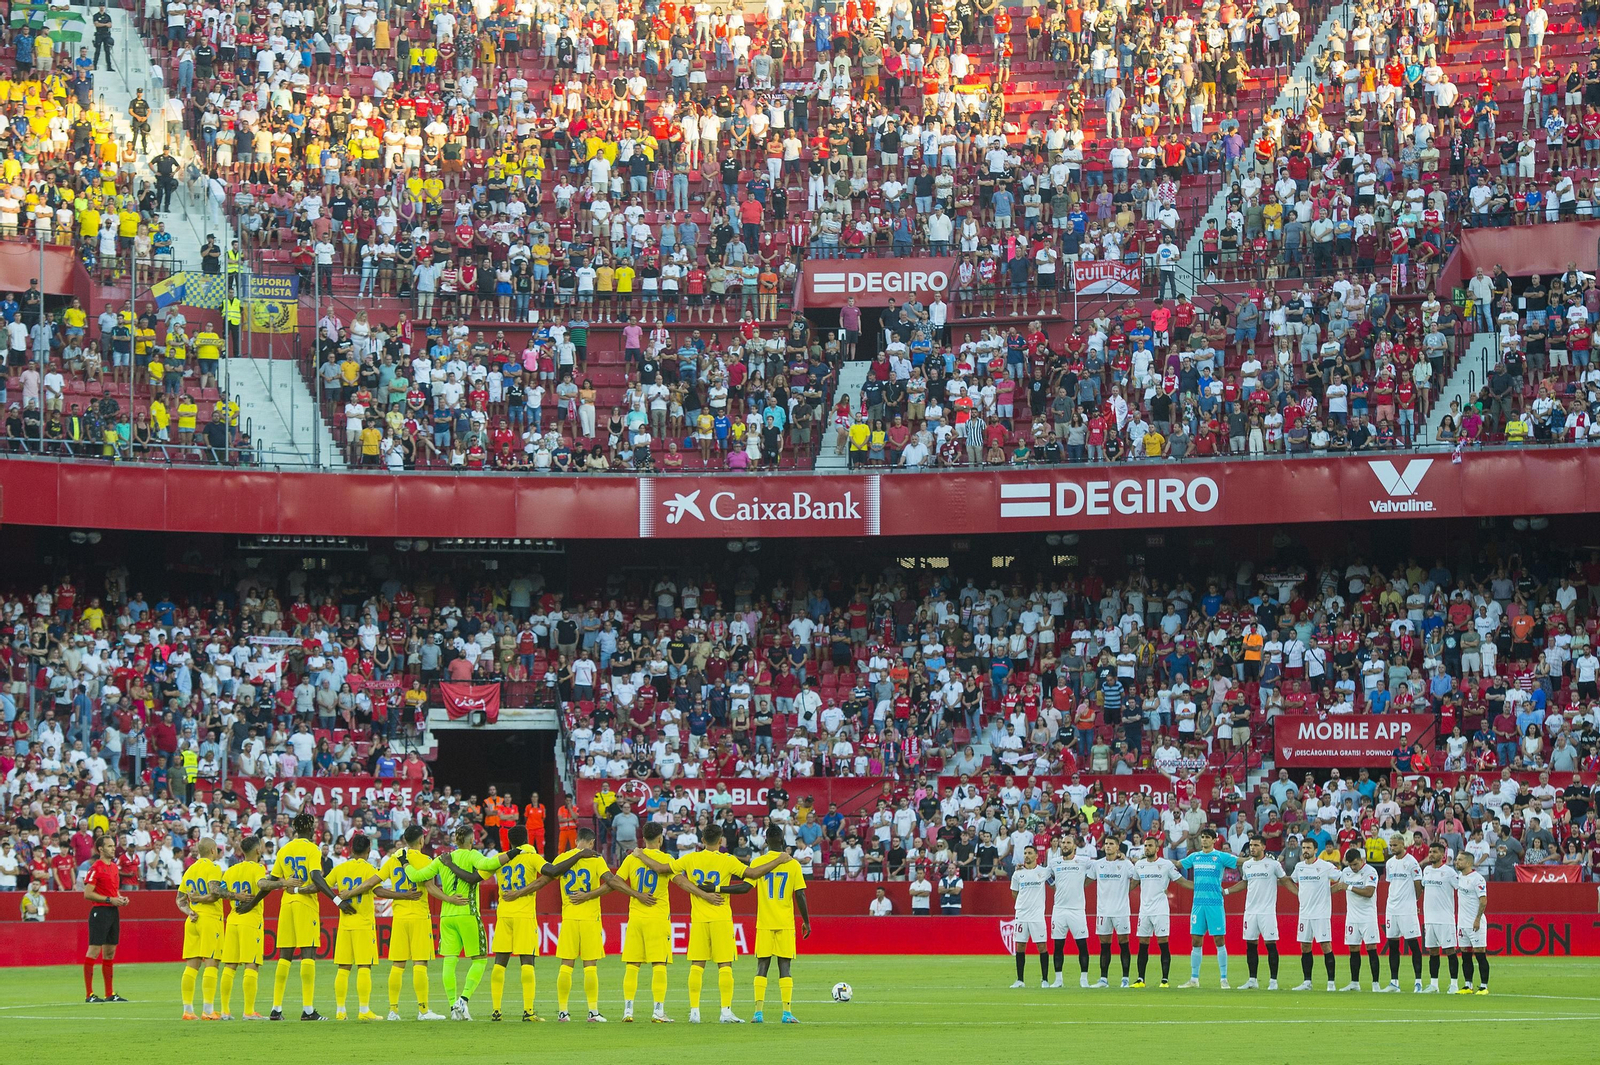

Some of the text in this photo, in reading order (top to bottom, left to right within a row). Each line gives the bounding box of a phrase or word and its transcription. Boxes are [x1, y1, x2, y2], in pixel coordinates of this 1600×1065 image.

[251, 278, 291, 287] EUFORIA
[848, 271, 948, 292] DEGIRO
[1076, 266, 1140, 281] GUILLENA
[251, 287, 291, 297] CADISTA
[1056, 476, 1219, 517] DEGIRO
[709, 491, 862, 522] CaixaBank
[1369, 499, 1434, 513] Valvoline
[1298, 722, 1369, 740] MOBILE
[1374, 722, 1412, 740] APP
[705, 788, 769, 806] PBLO
[501, 863, 526, 891] 33
[563, 868, 591, 895] 23
[636, 866, 659, 895] 19
[763, 871, 789, 900] 17
[1014, 923, 1023, 933] 16
